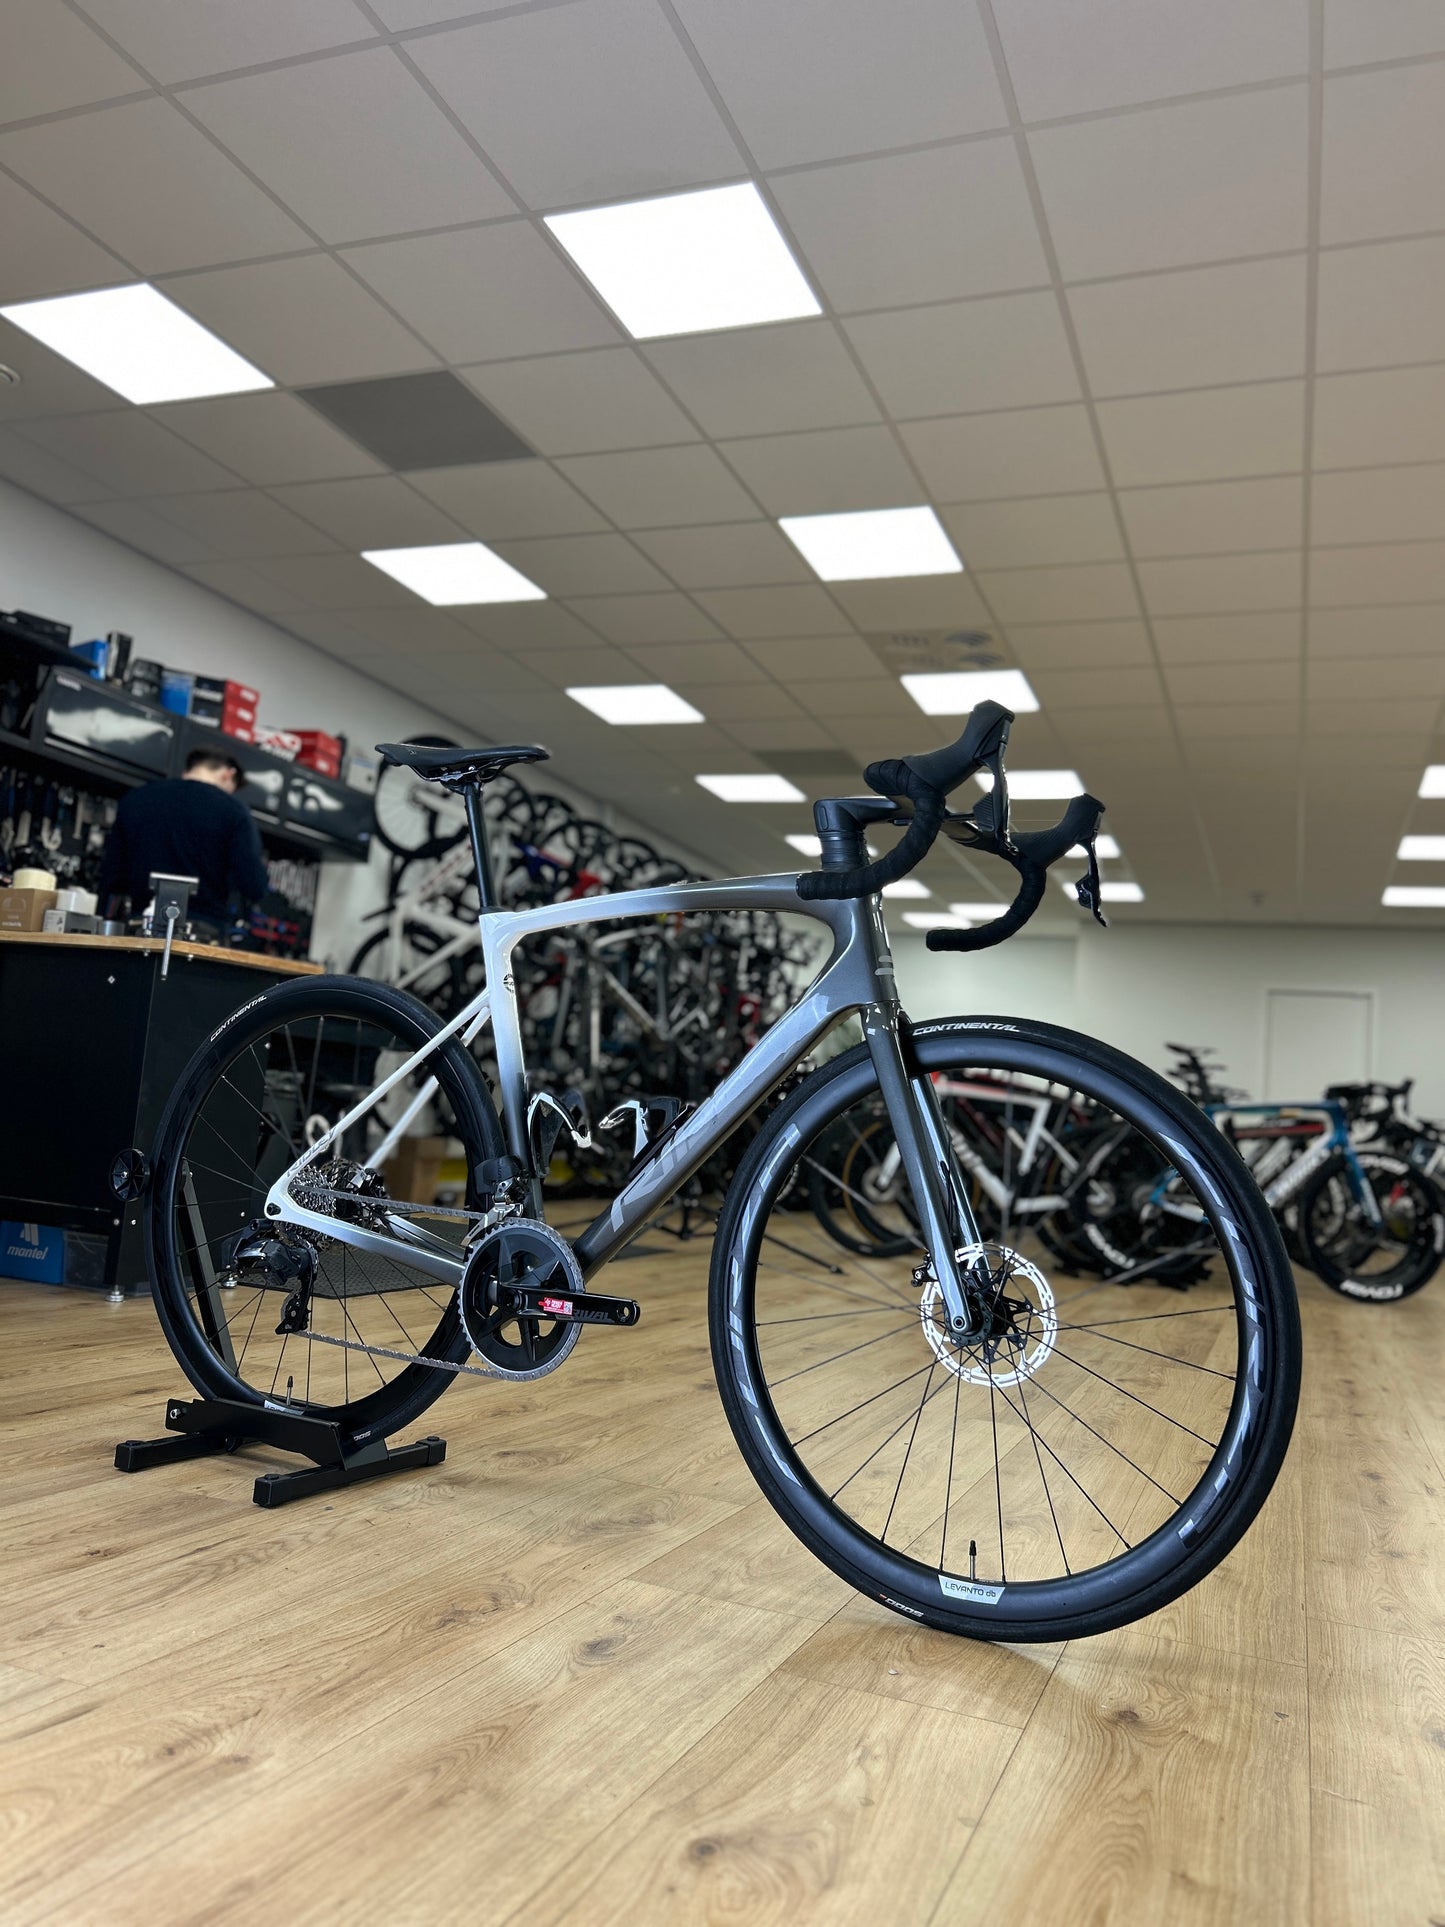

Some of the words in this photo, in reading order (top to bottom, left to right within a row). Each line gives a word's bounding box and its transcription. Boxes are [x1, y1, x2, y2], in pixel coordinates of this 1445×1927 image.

[210, 995, 267, 1042] CONTINENTAL
[912, 1022, 1020, 1036] CONTINENTAL
[287, 1126, 337, 1178] RIDLEY
[7, 1246, 49, 1260] mantel
[945, 1581, 984, 1596] LEVANTO
[885, 1597, 924, 1617] 5000
